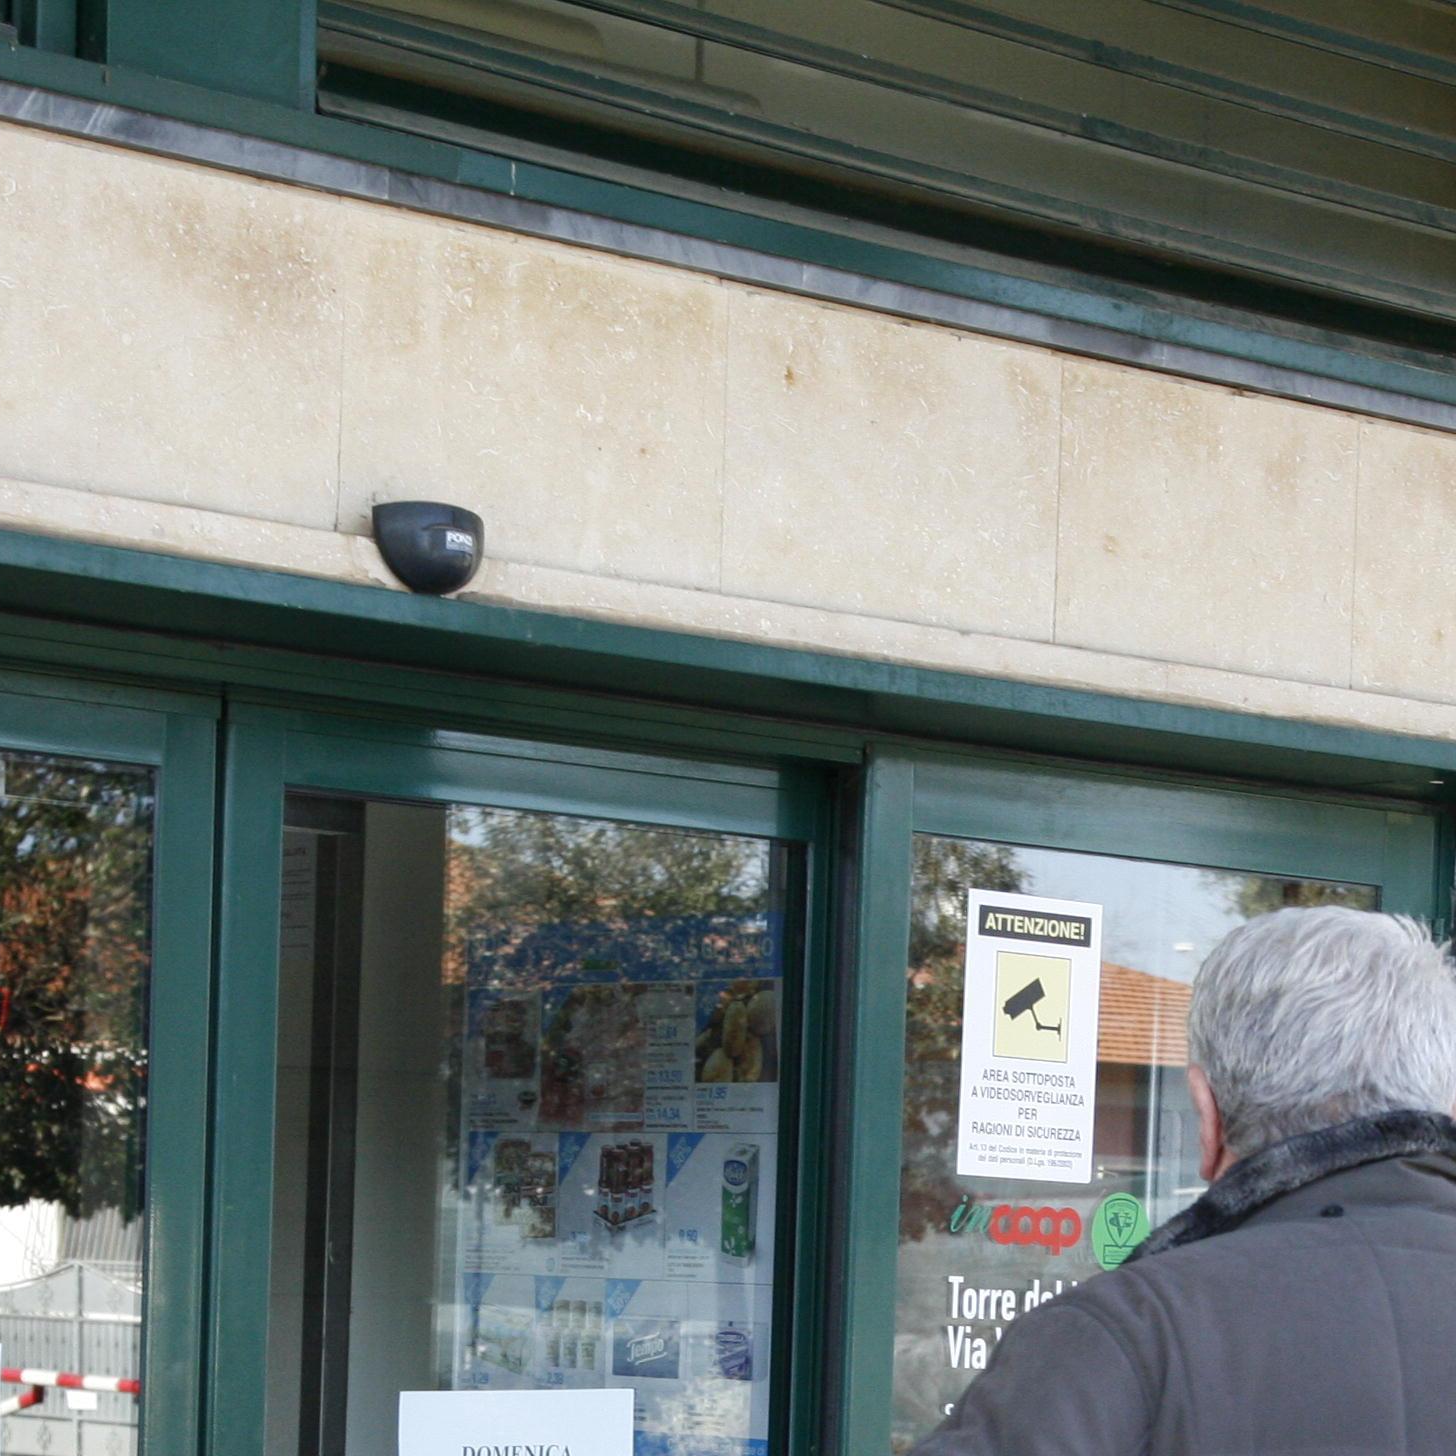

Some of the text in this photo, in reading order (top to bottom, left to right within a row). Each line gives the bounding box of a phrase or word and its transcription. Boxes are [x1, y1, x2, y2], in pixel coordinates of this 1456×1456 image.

[985, 912, 1085, 940] ATTENZIONE!
[982, 1068, 1076, 1088] AREA SOTTOPOSTA
[971, 1085, 1085, 1107] A VIDEOSORVEGLIANZA
[1018, 1106, 1038, 1120] PER
[971, 1121, 1082, 1141] RAGIONI DI SICUREZZA
[948, 1275, 1016, 1321] Torre
[947, 1325, 987, 1370] Via
